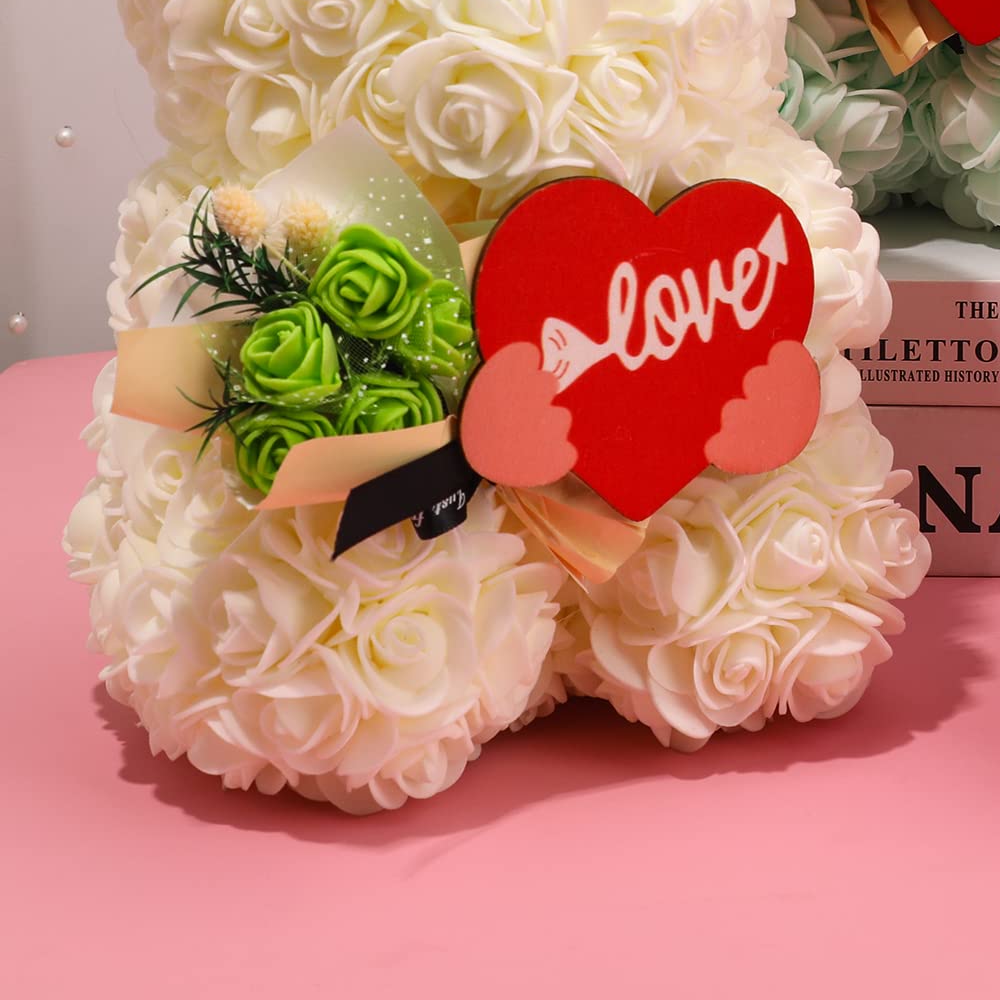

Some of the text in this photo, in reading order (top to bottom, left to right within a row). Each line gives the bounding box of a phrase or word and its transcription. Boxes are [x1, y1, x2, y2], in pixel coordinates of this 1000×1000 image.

[605, 247, 774, 371] love
[955, 301, 1000, 319] THE
[860, 369, 940, 382] LLUSTRATED
[945, 370, 999, 383] HISTORY
